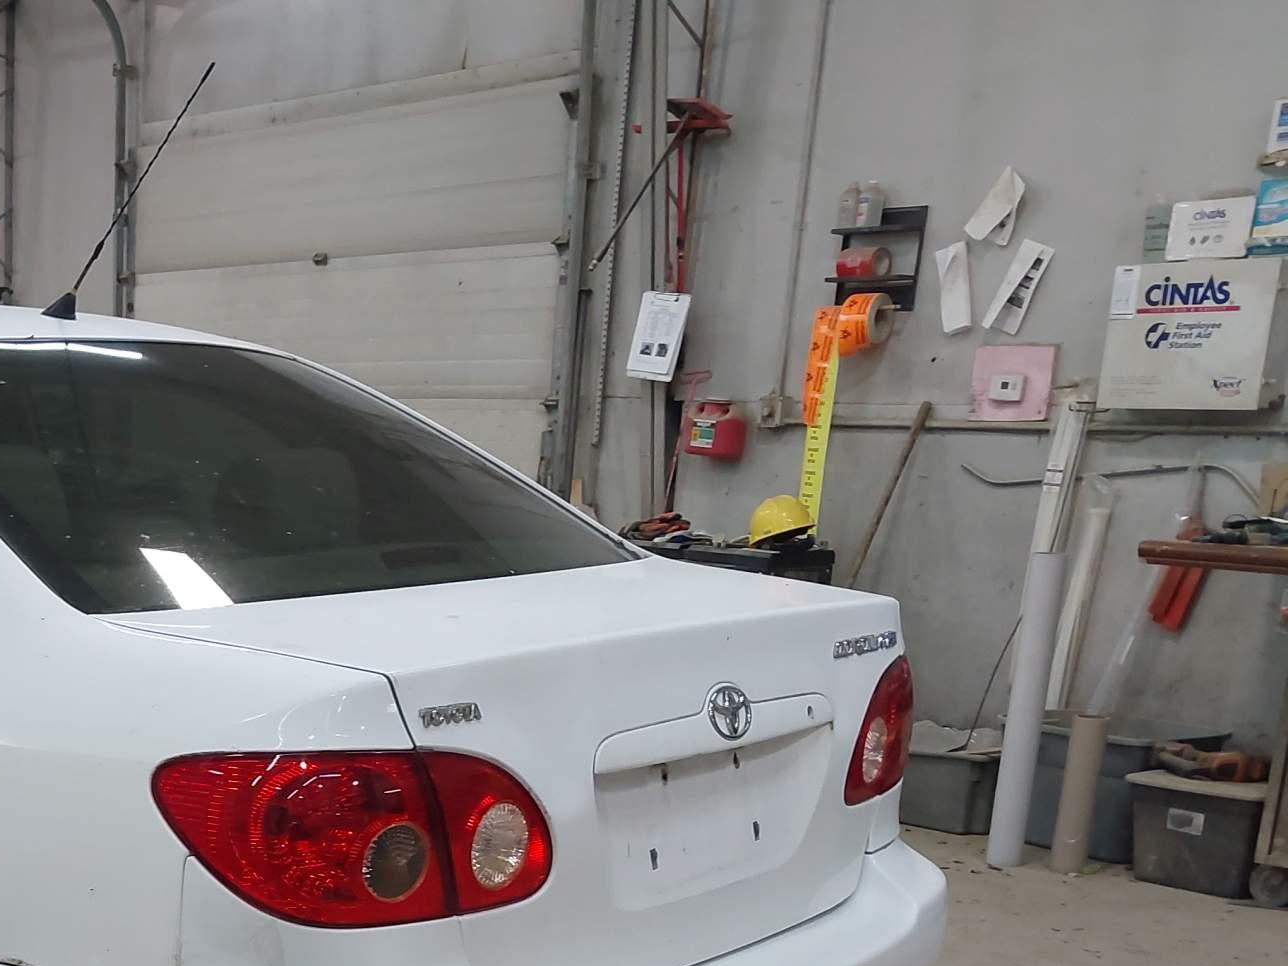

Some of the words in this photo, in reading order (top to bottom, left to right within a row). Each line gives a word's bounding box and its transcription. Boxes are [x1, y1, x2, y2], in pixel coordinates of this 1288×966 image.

[1176, 321, 1223, 331] Employee
[1172, 331, 1193, 340] First
[1195, 331, 1212, 340] Aid
[1168, 341, 1203, 349] Station
[419, 702, 482, 728] TOYOTA
